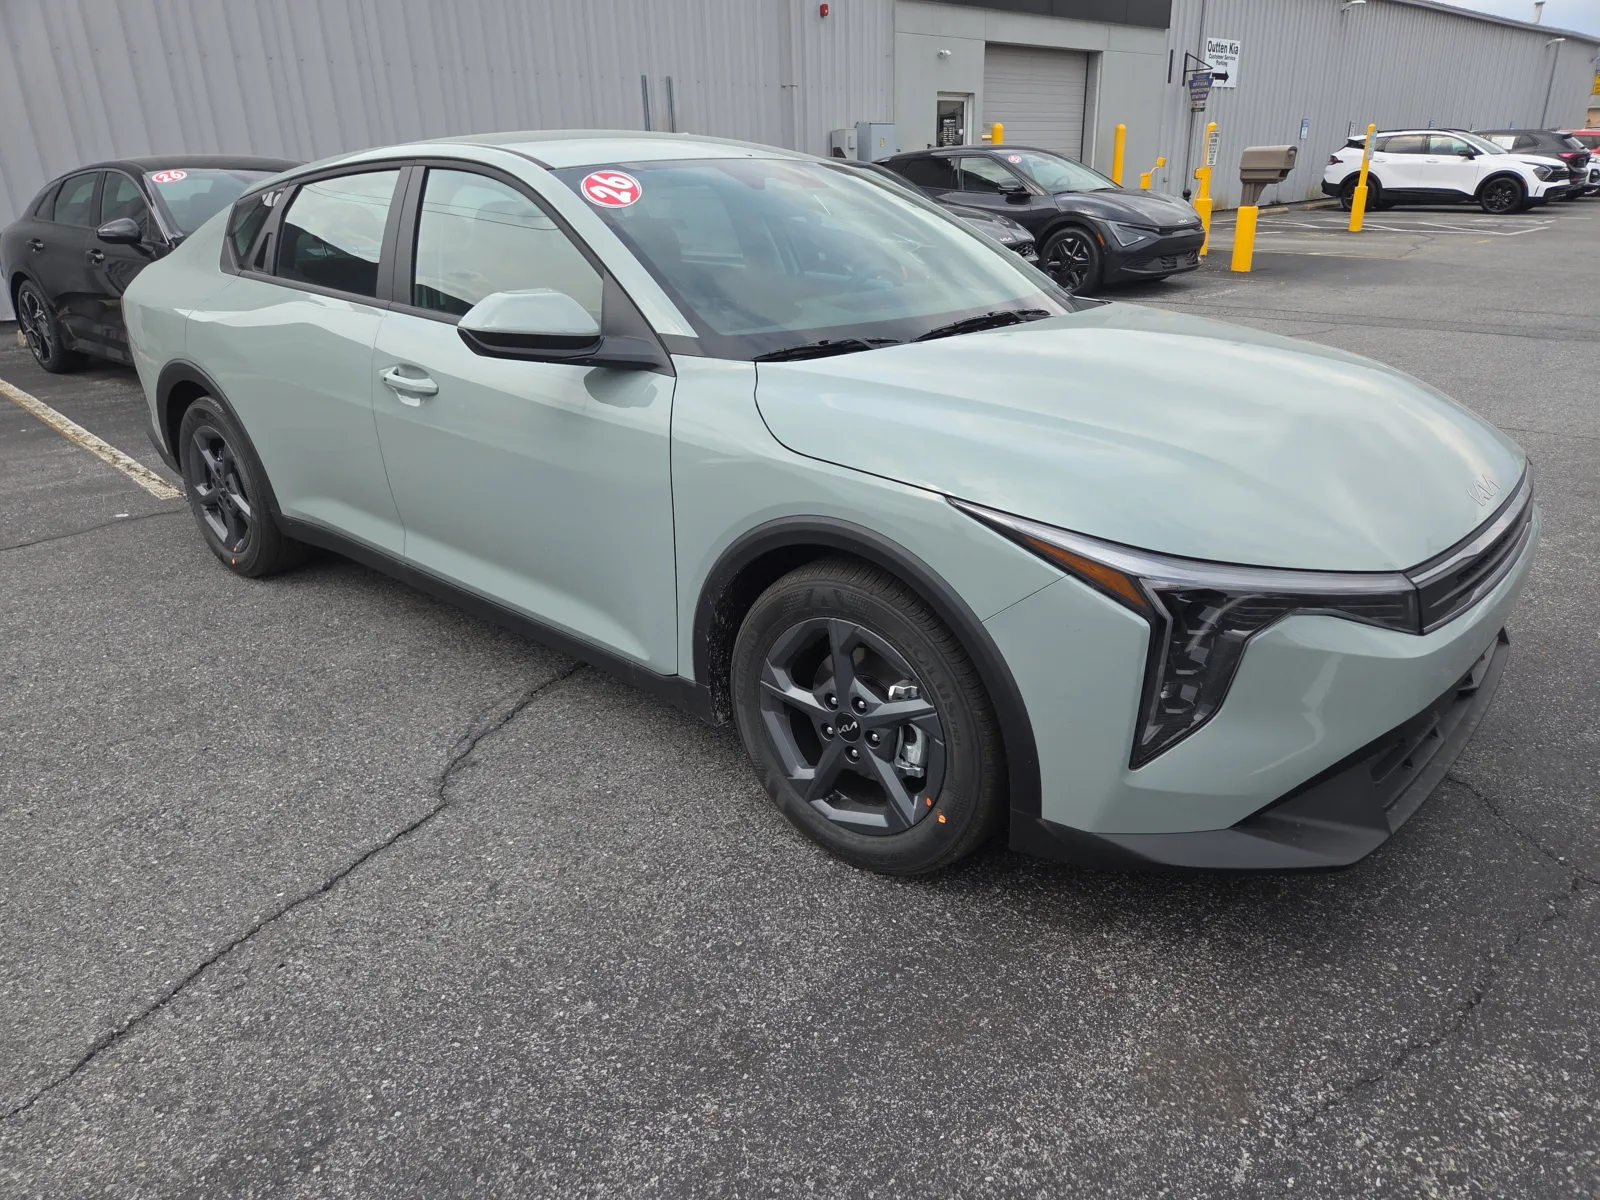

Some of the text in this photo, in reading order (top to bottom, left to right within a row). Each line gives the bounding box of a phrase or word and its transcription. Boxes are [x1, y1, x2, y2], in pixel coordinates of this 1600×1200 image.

[1208, 40, 1238, 54] Outten Kia
[158, 170, 183, 182] 26
[590, 174, 634, 203] 26
